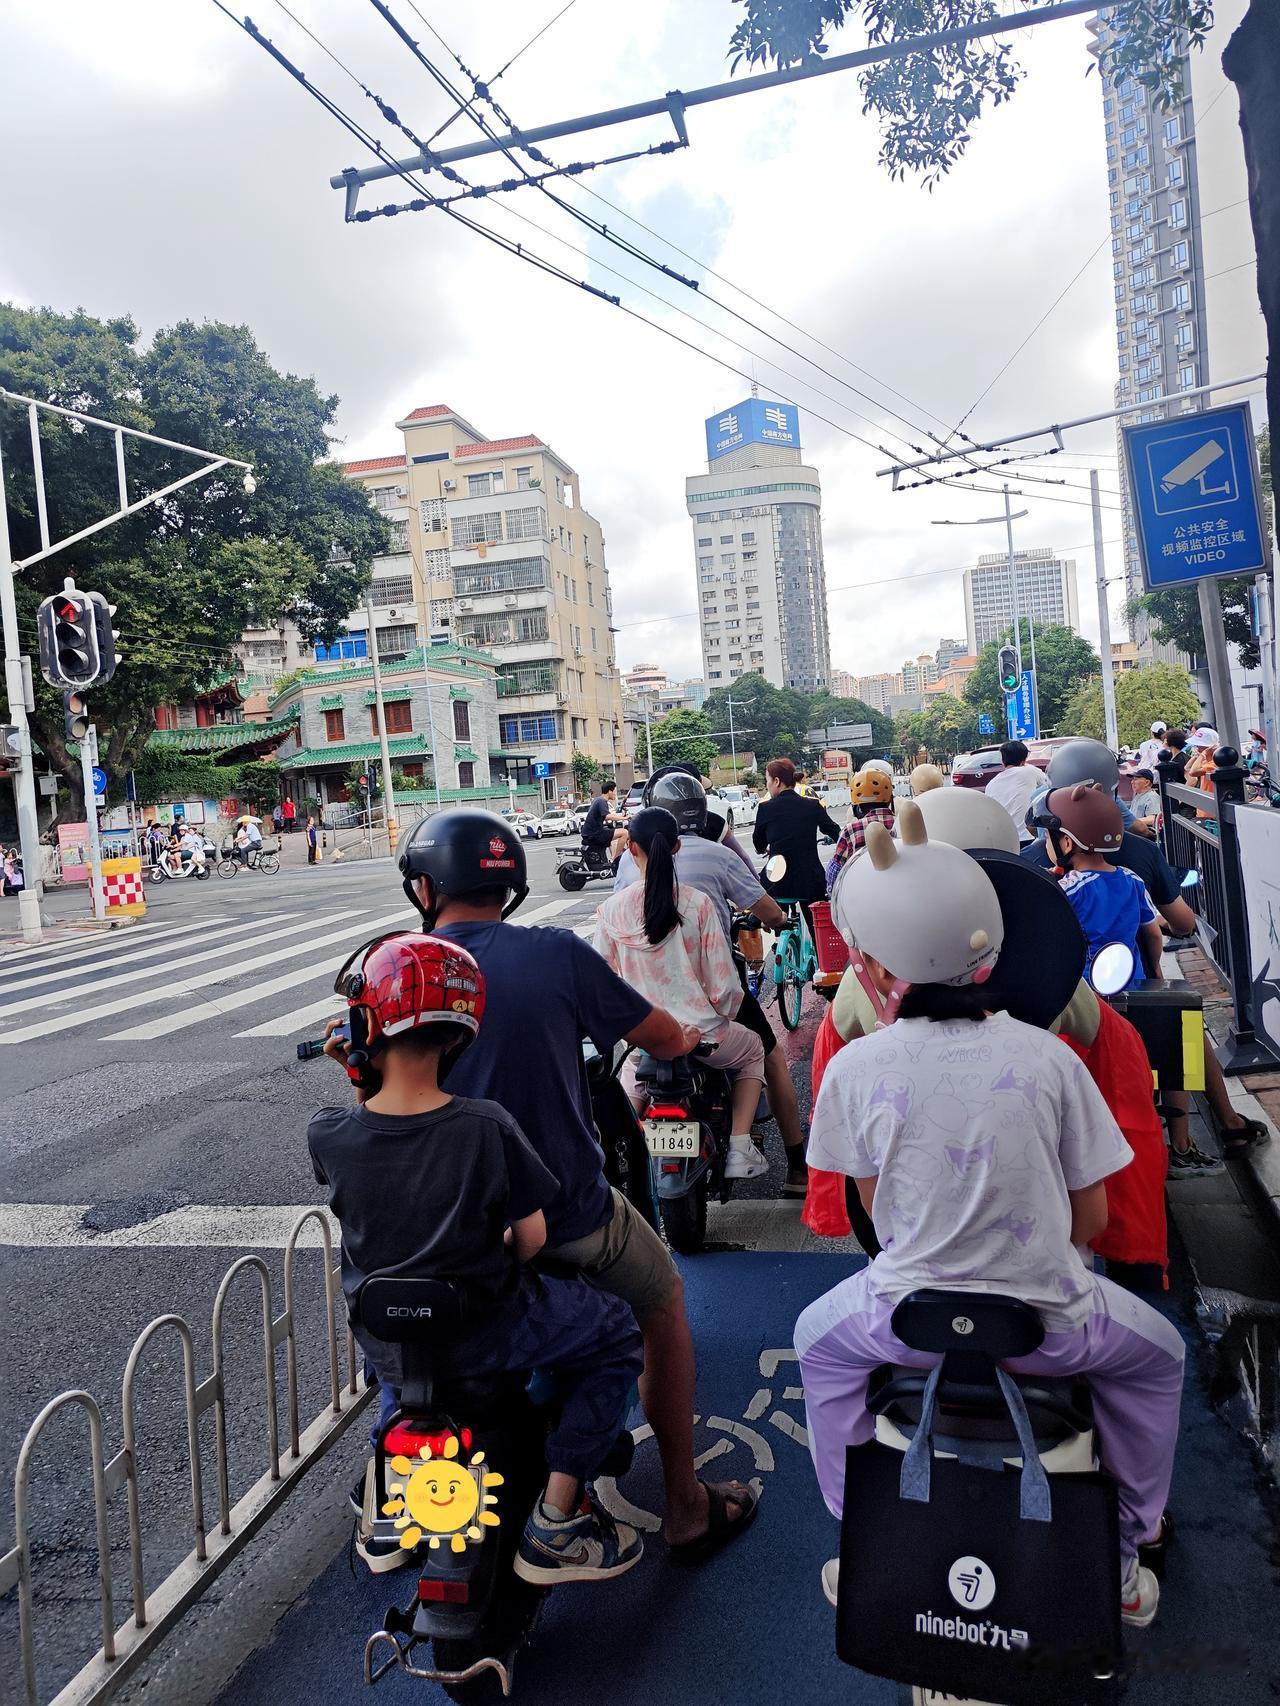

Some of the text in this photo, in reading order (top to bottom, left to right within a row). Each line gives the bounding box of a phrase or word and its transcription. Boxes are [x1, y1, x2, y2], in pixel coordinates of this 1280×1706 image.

[1173, 518, 1229, 538] 公共安全
[1161, 530, 1246, 556] 视频监控区域
[1184, 549, 1226, 566] VIDEO
[536, 763, 545, 775] P
[456, 1001, 463, 1010] A
[646, 1137, 693, 1150] 11849
[386, 1306, 432, 1318] GOVA
[915, 1610, 987, 1645] ninebot
